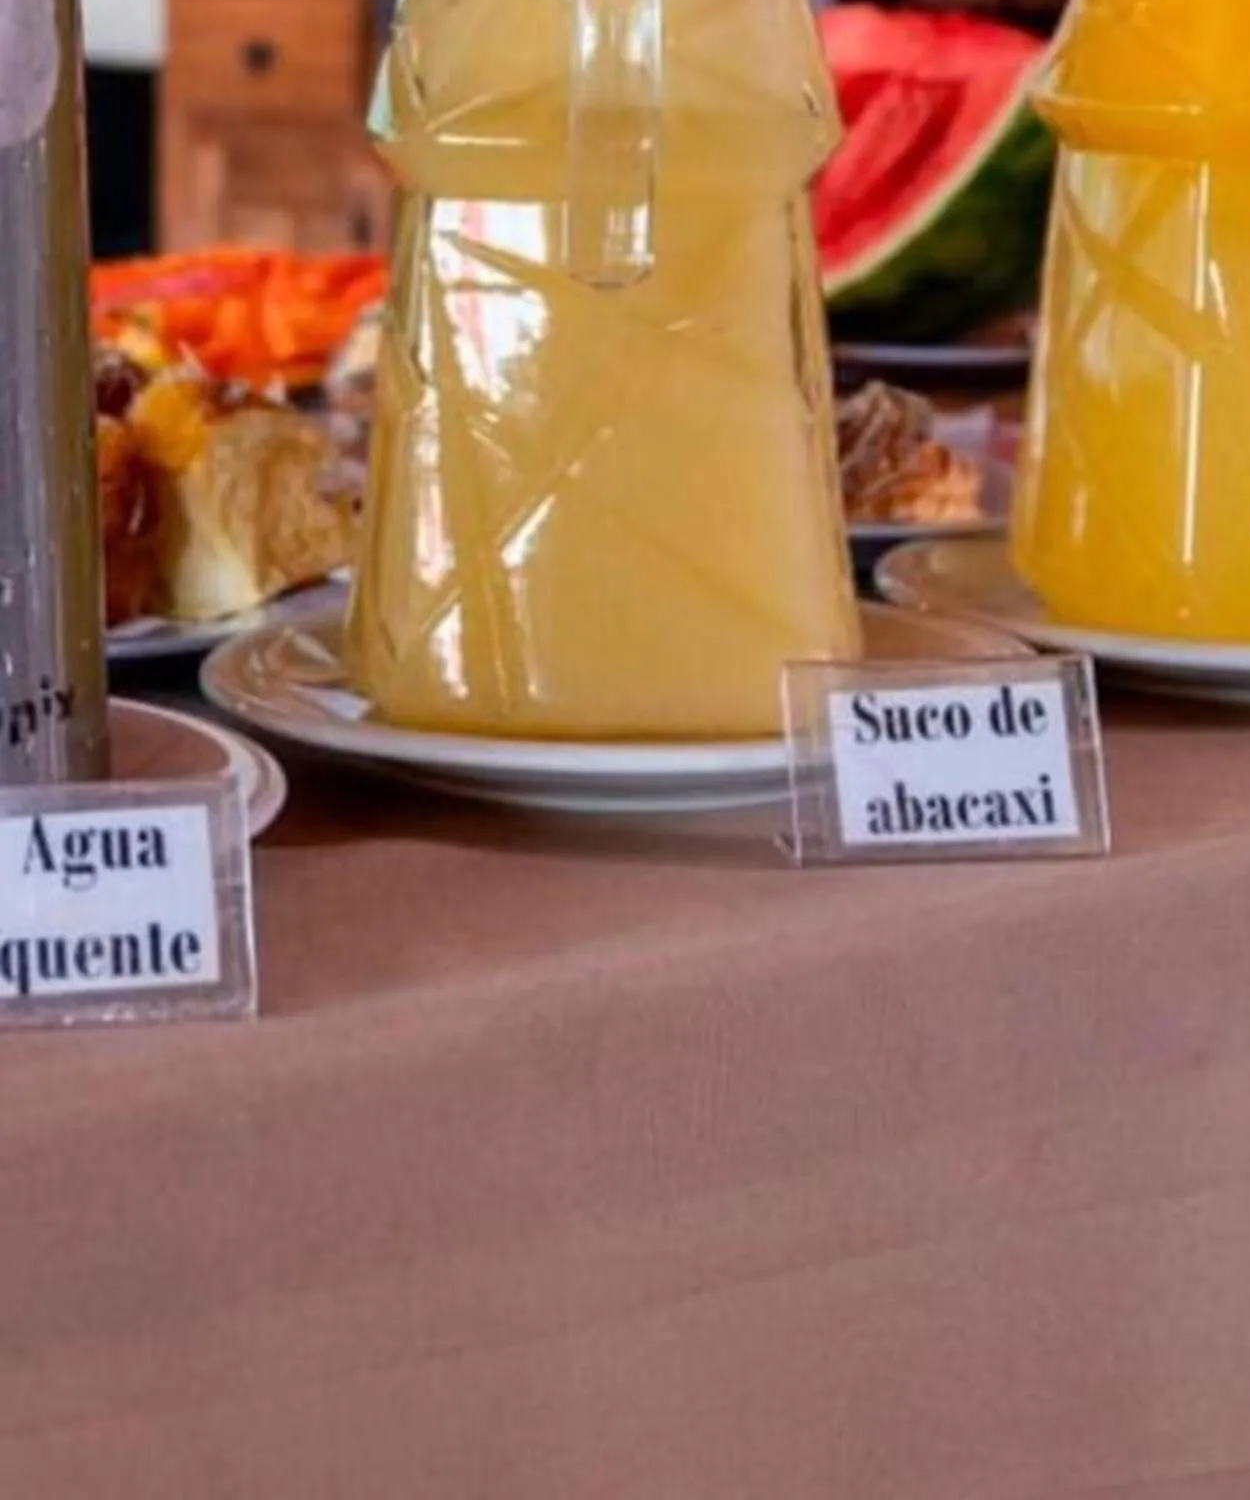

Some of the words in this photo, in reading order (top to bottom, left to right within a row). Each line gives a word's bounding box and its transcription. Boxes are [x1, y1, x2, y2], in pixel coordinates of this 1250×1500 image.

[853, 691, 973, 746] Suco
[988, 685, 1048, 739] de
[865, 772, 1058, 836] abacaxi
[0, 921, 201, 997] quente
